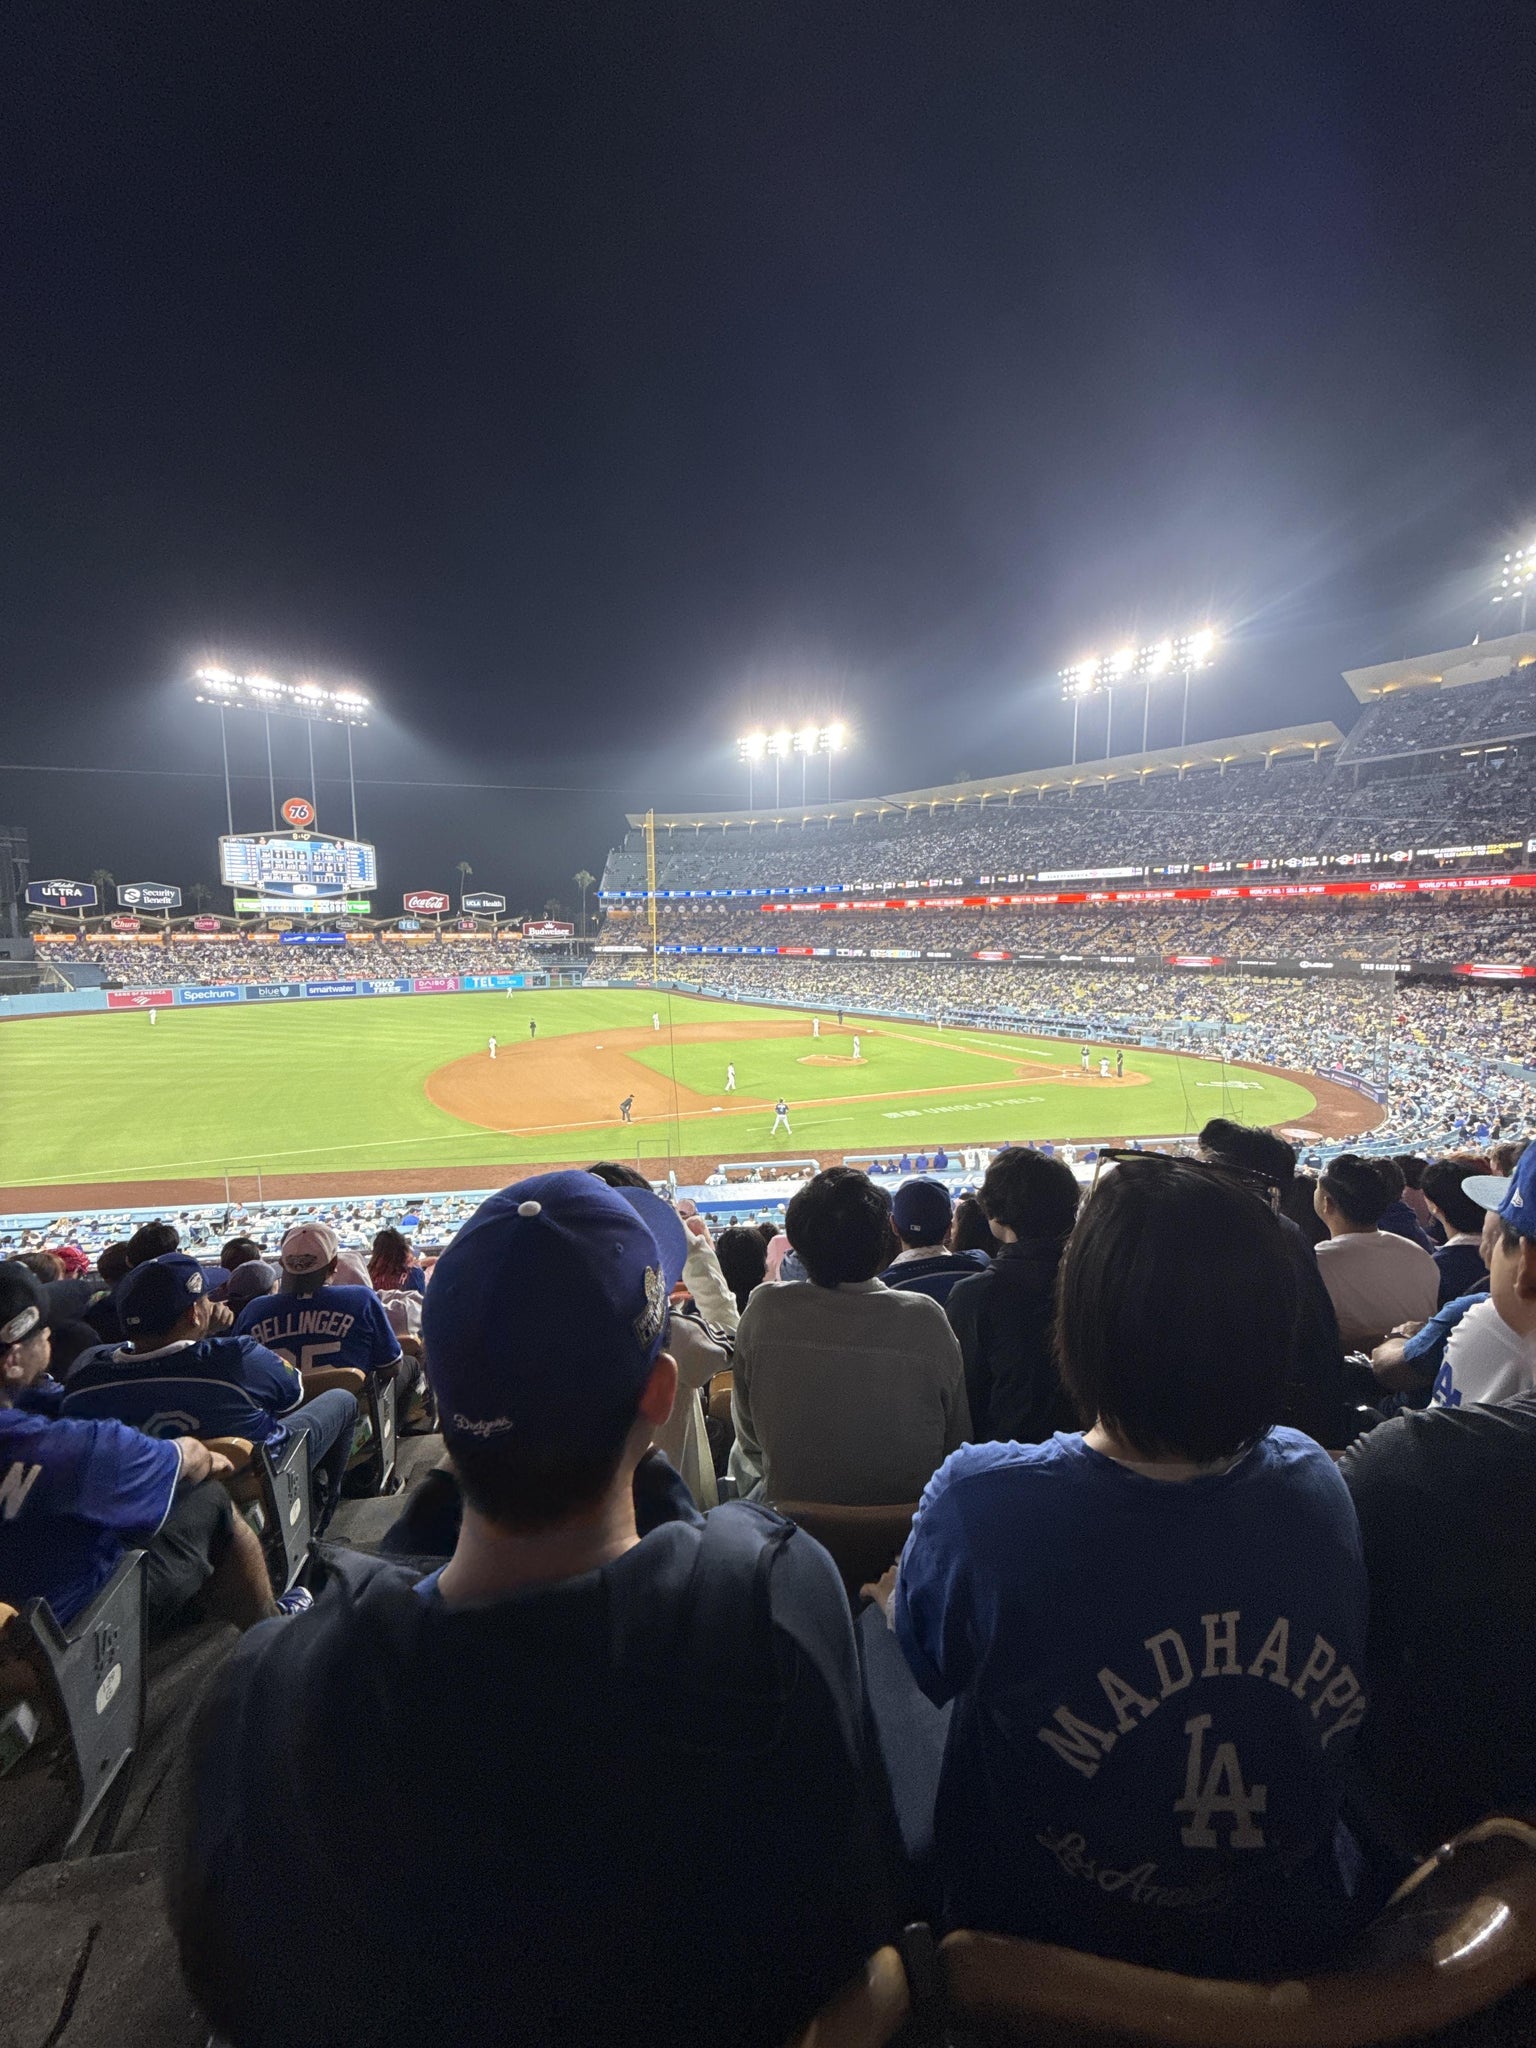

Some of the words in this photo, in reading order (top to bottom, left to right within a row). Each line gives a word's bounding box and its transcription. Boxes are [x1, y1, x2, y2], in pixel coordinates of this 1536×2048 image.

[289, 805, 309, 819] 76
[1464, 879, 1490, 887] SELLING
[1490, 878, 1512, 886] SPIRIT
[41, 888, 83, 897] ULTRA
[142, 888, 176, 899] Security
[143, 896, 172, 904] Benefit
[113, 920, 139, 928] Churu
[528, 927, 570, 936] Budweiser
[368, 980, 395, 988] TOYO
[472, 976, 495, 988] TEL
[258, 987, 280, 996] blue
[308, 984, 355, 994] smartwater
[373, 986, 401, 994] TIRES
[183, 990, 232, 1002] Spectrum
[923, 1102, 992, 1114] UNIQLO
[251, 1310, 355, 1344] BELLINGER
[453, 1414, 513, 1438] Dodgers
[1036, 1609, 1367, 1780] MADHAPPY
[1173, 1713, 1268, 1850] LA
